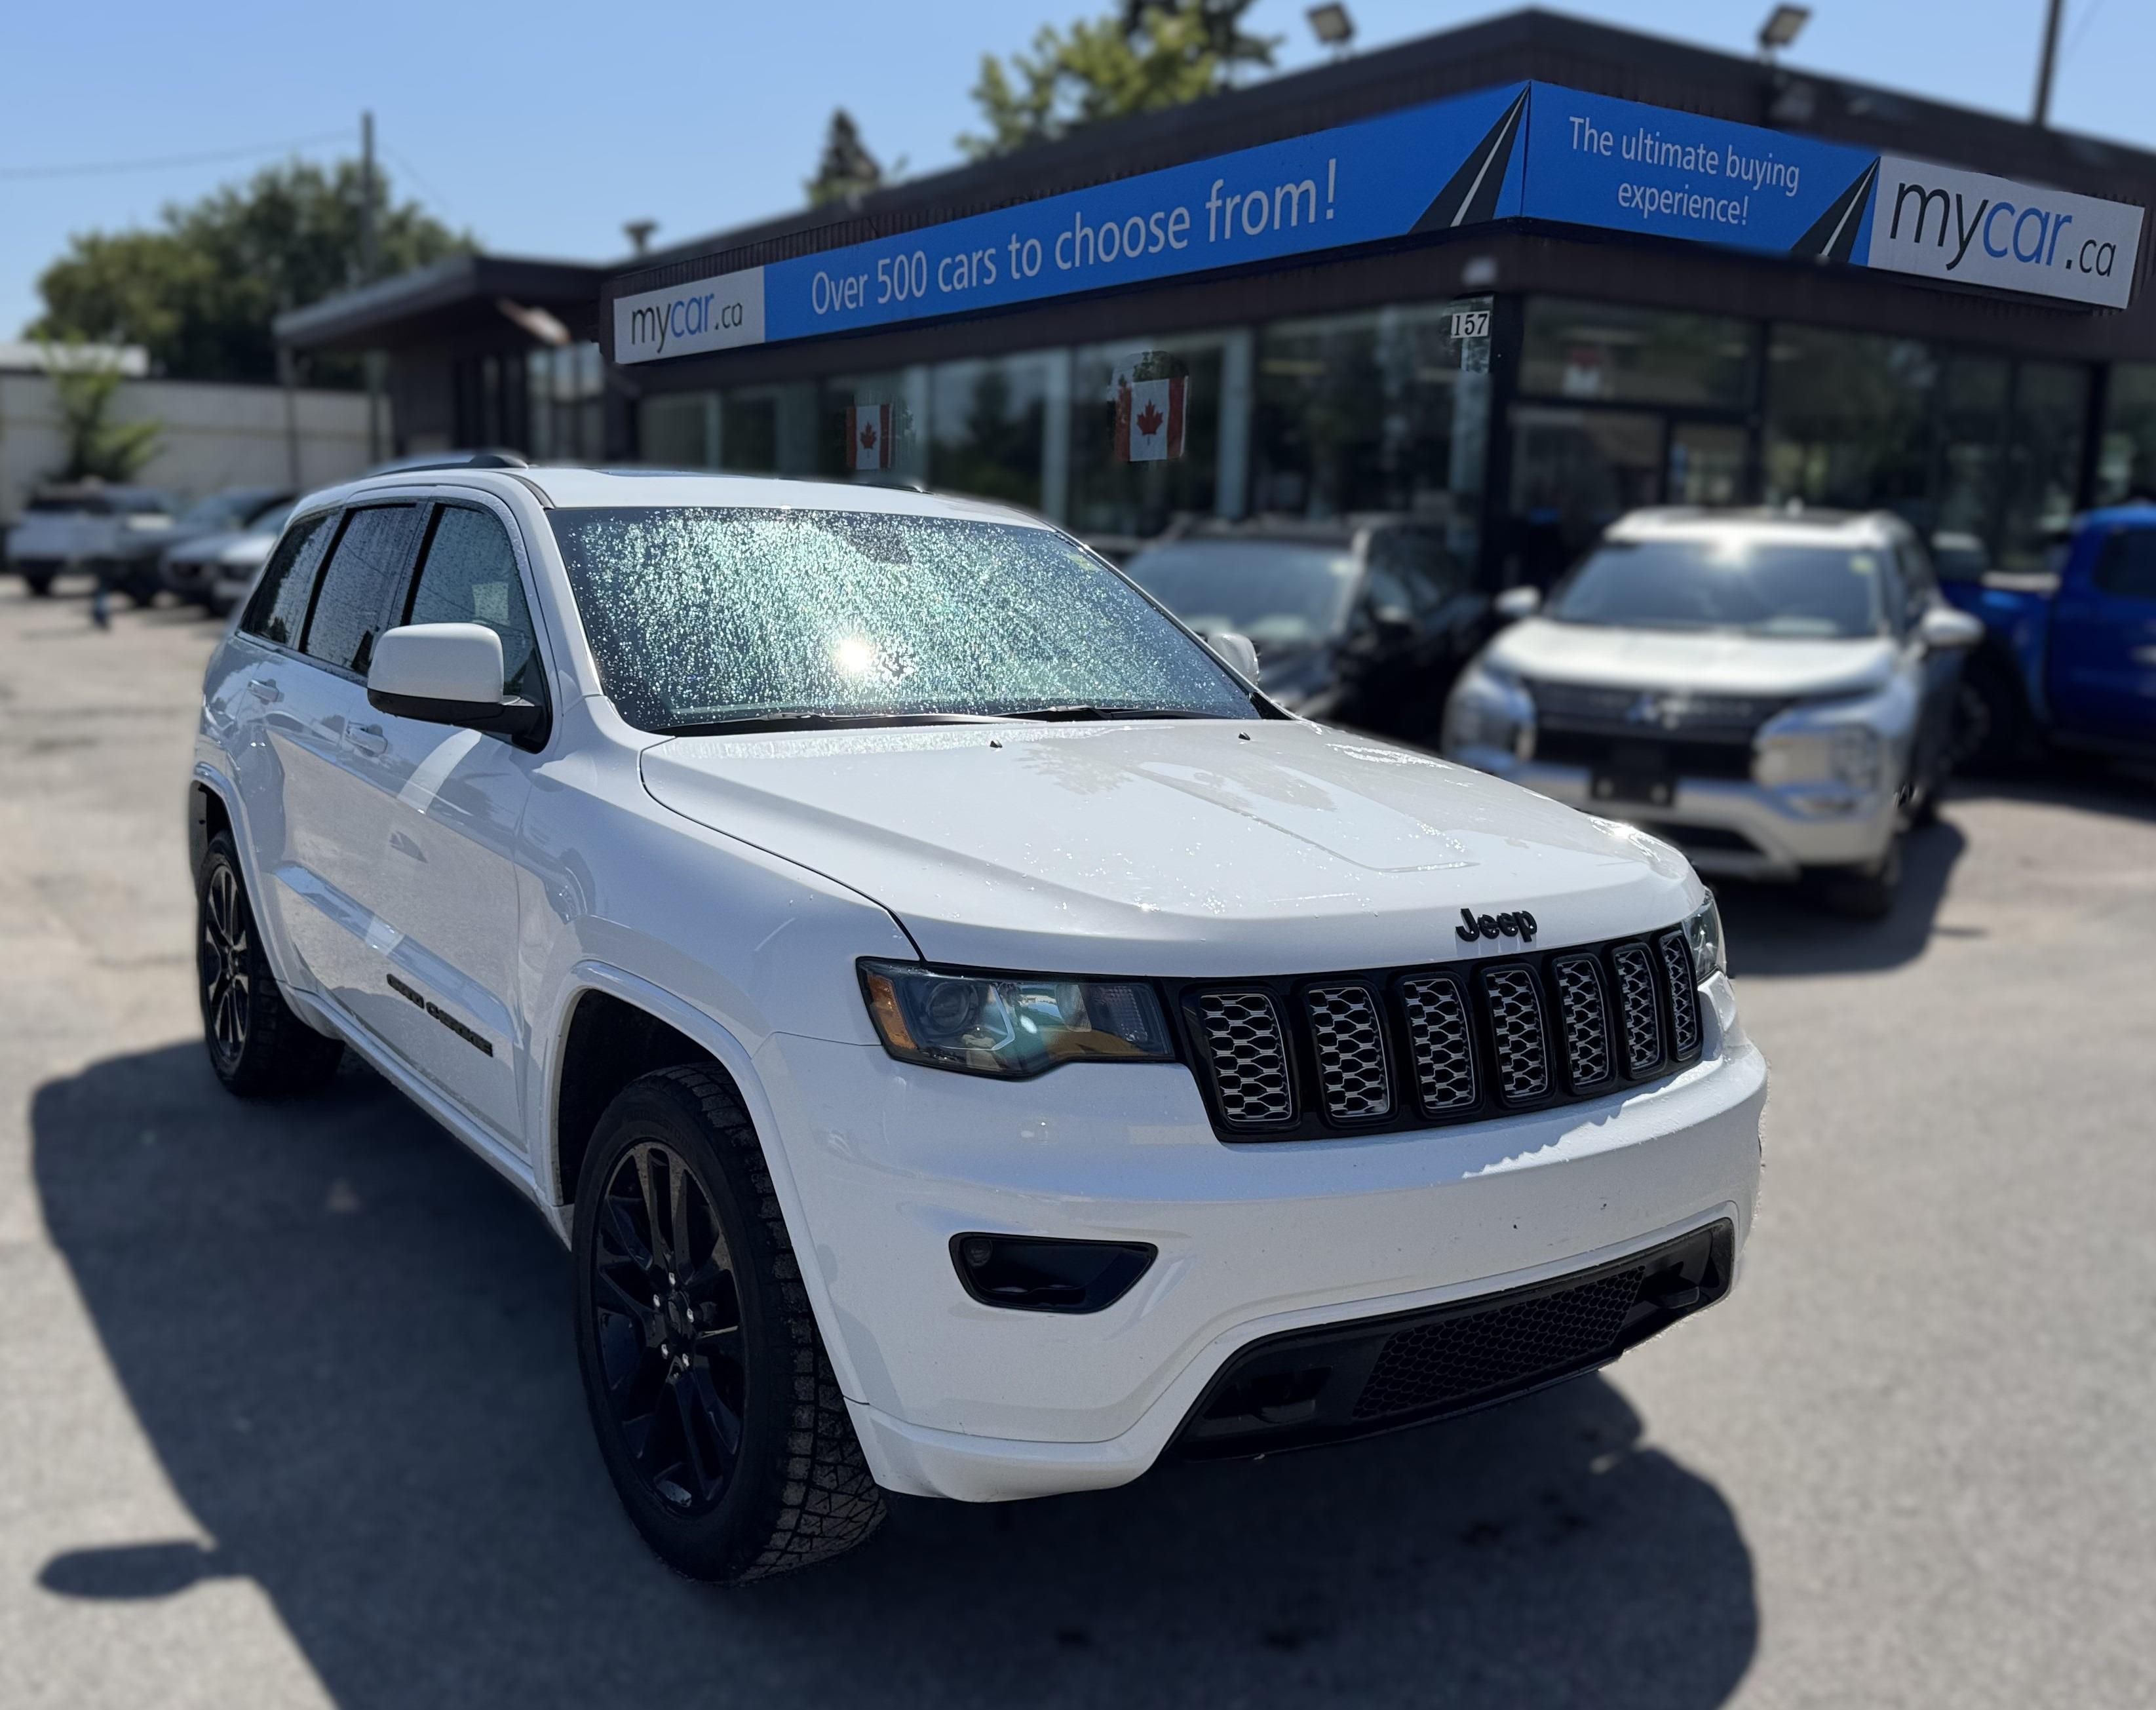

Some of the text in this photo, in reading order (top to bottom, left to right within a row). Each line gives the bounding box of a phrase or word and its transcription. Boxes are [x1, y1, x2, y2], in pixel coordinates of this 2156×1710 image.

[1569, 117, 1799, 197] The ultimate buying
[1618, 183, 1748, 225] experience!
[1889, 182, 2116, 278] mycar.ca
[812, 159, 1336, 315] Over 500 cars to choose from!
[631, 292, 742, 354] mycar.ca
[1453, 313, 1488, 336] 157
[1455, 908, 1537, 942] Jeep
